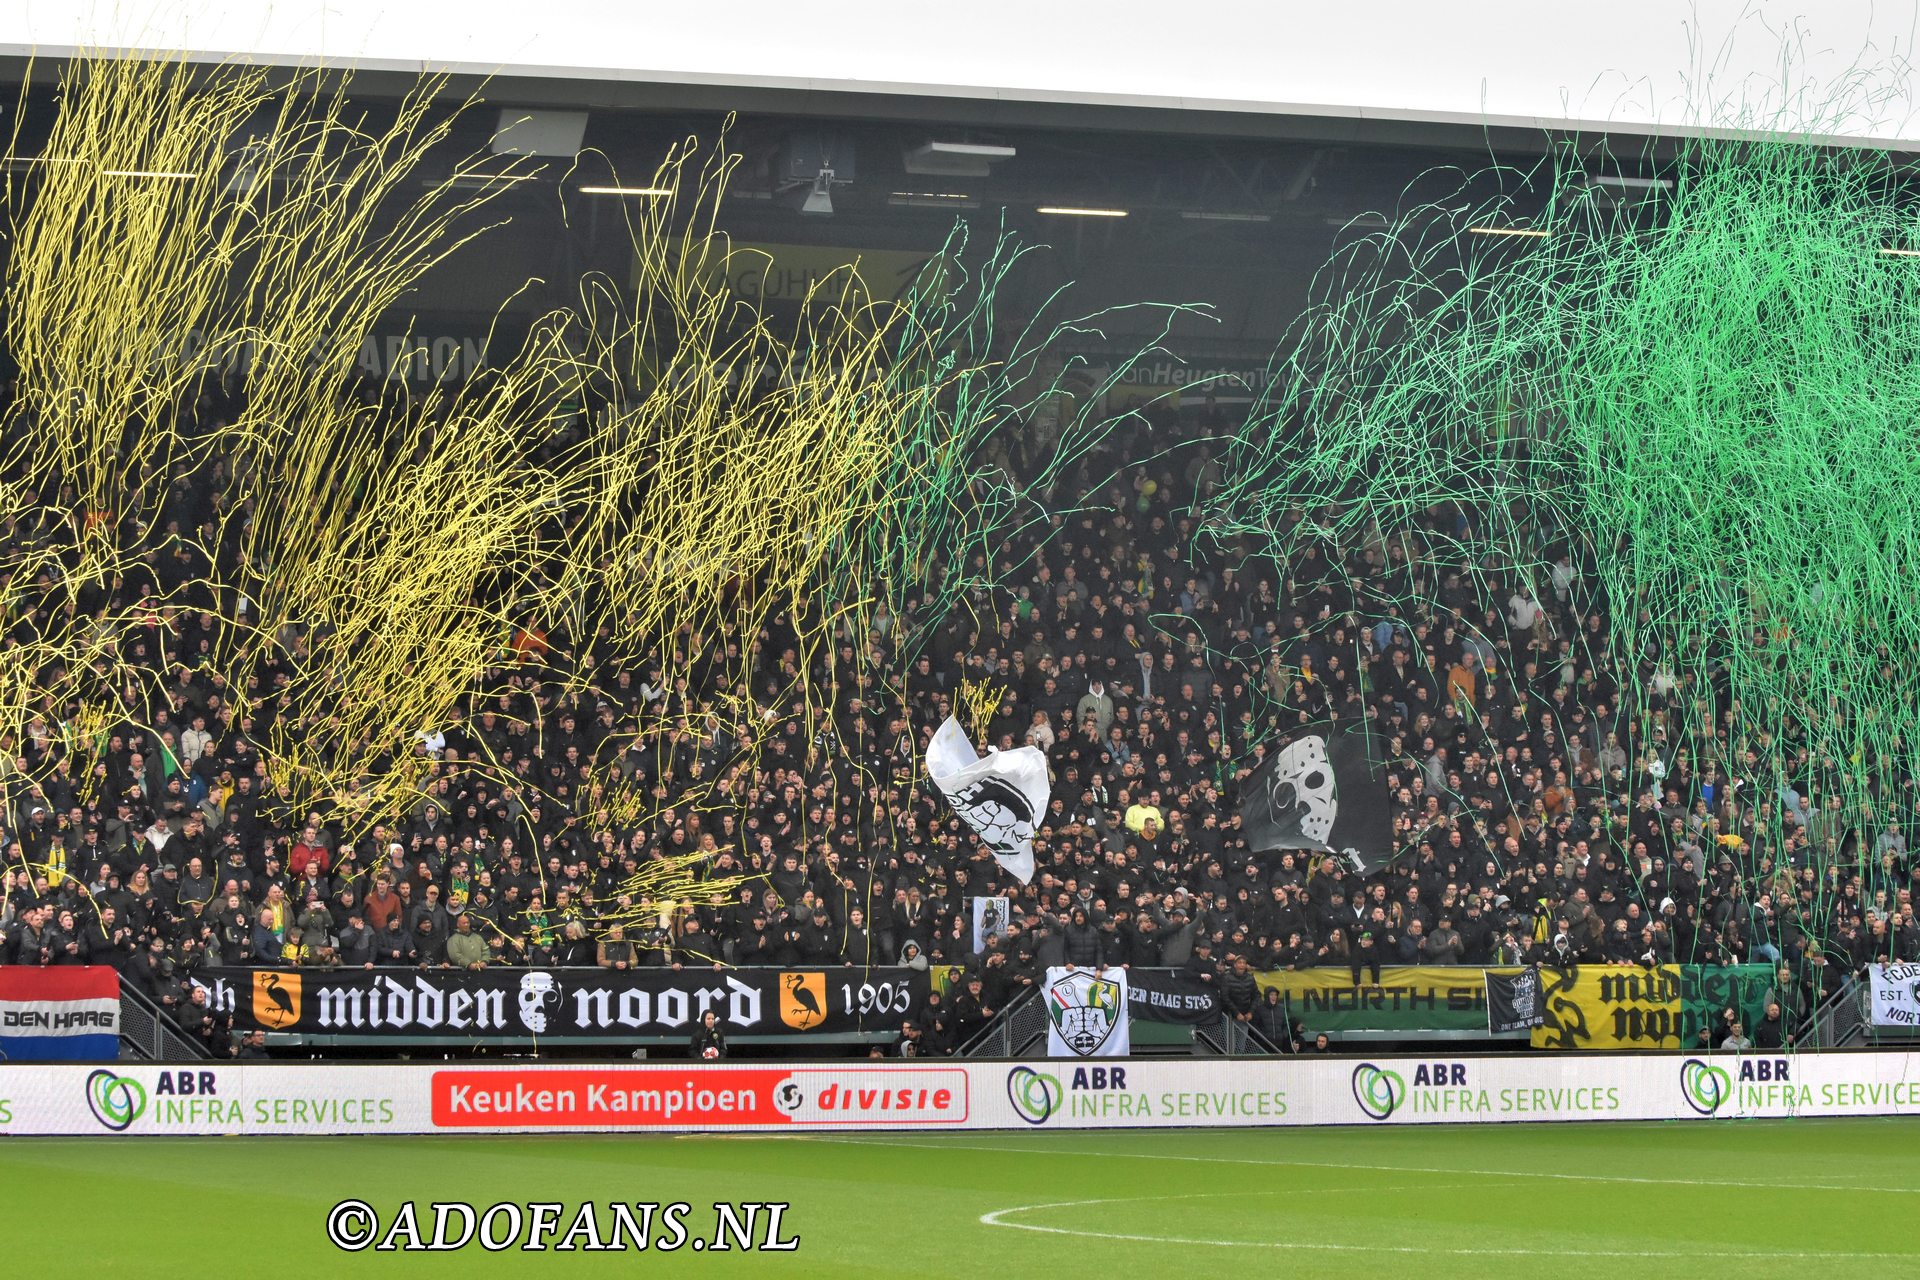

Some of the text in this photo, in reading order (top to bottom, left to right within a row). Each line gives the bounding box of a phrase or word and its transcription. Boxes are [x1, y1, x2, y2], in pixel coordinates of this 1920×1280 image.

[317, 974, 507, 1029] midden
[572, 975, 762, 1028] noord
[841, 980, 911, 1016] 1905
[1303, 987, 1435, 1012] NORTH
[1447, 987, 1488, 1012] SI
[1880, 990, 1907, 1001] EST.
[3, 1010, 115, 1029] DEN HAAG
[1071, 1067, 1127, 1090] ABR
[1414, 1063, 1467, 1086] ABR
[1739, 1059, 1789, 1082] ABR
[156, 1071, 217, 1095] ABR
[156, 1098, 393, 1124] INFRA SERVICES
[450, 1081, 952, 1119] Keuken Kampioen divisie
[1071, 1091, 1288, 1118] INFRA SERVICES
[1414, 1087, 1620, 1113] INFRA SERVICES
